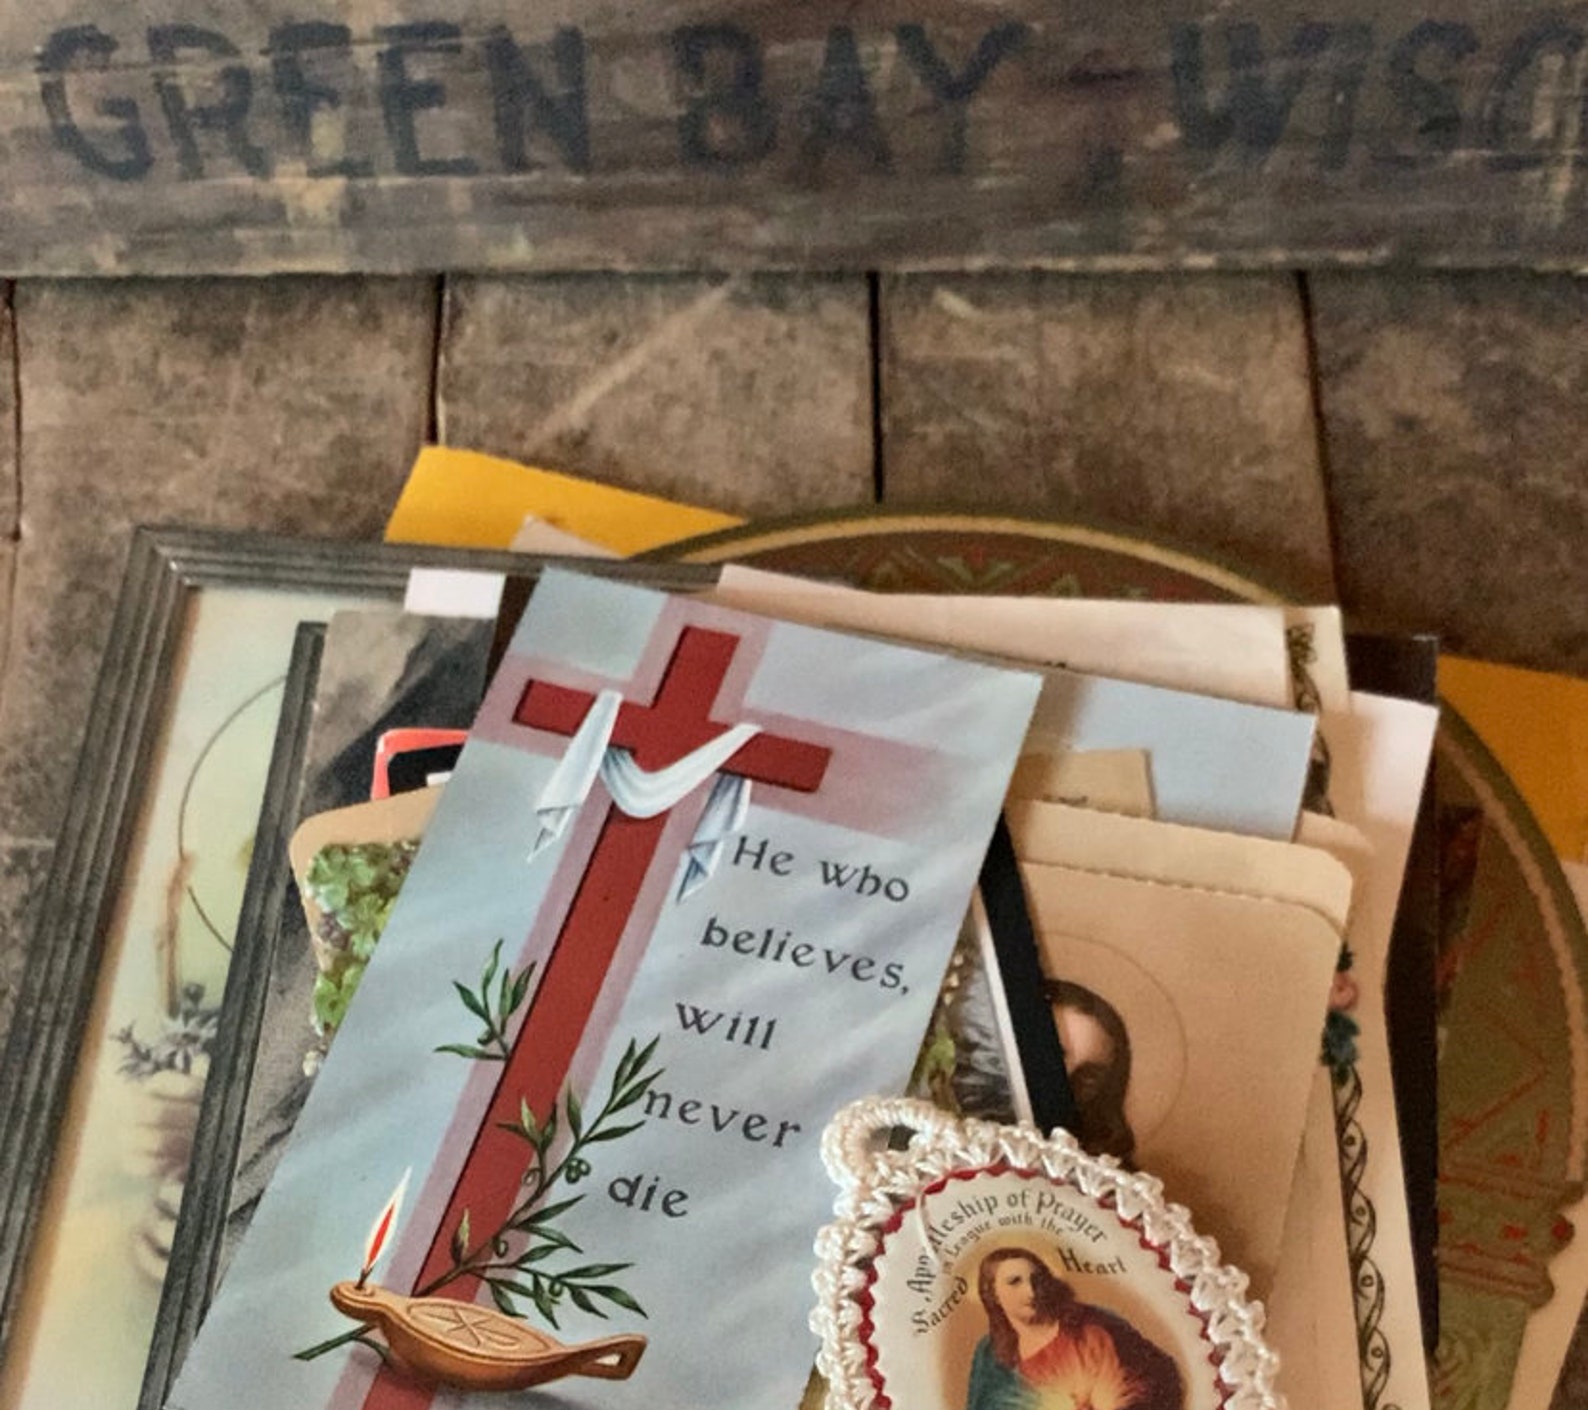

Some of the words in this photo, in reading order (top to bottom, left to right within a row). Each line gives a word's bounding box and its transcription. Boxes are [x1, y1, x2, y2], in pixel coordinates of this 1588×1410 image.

[36, 20, 592, 182] GREEN
[731, 834, 795, 876] He
[818, 859, 911, 902] who
[700, 916, 911, 996] believes,
[674, 1001, 779, 1050] will
[643, 1086, 802, 1148] never
[607, 1172, 690, 1219] die
[998, 1212, 1033, 1227] with
[1041, 1216, 1064, 1236] the
[1006, 1188, 1030, 1208] of
[1035, 1189, 1108, 1243] Prayer
[911, 1275, 969, 1334] Sacred
